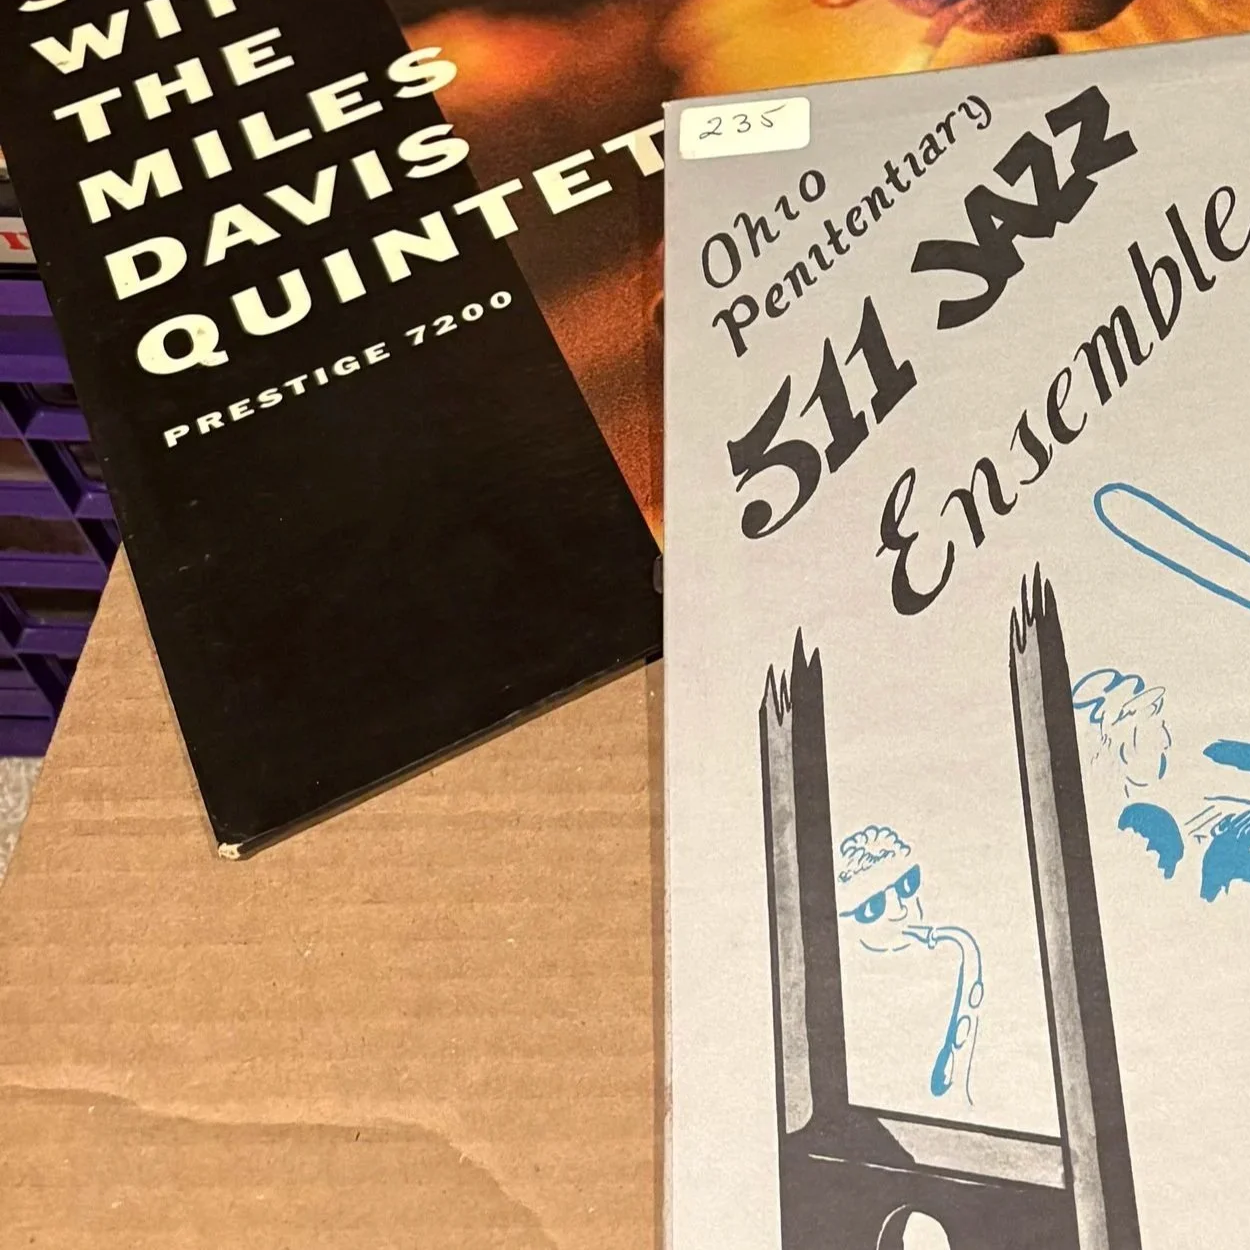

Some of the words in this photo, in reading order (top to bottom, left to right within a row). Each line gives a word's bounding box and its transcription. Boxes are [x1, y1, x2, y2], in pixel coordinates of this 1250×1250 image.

[53, 28, 296, 143] THE
[77, 46, 458, 225] MILES
[698, 103, 787, 141] 235
[103, 123, 471, 302] DAVIS
[136, 120, 664, 376] QUINTET
[701, 168, 827, 289] Ohio
[164, 342, 391, 448] PRESTIGE
[405, 289, 513, 347] 7200
[726, 296, 918, 540] 511
[910, 85, 1138, 331] JAZZ
